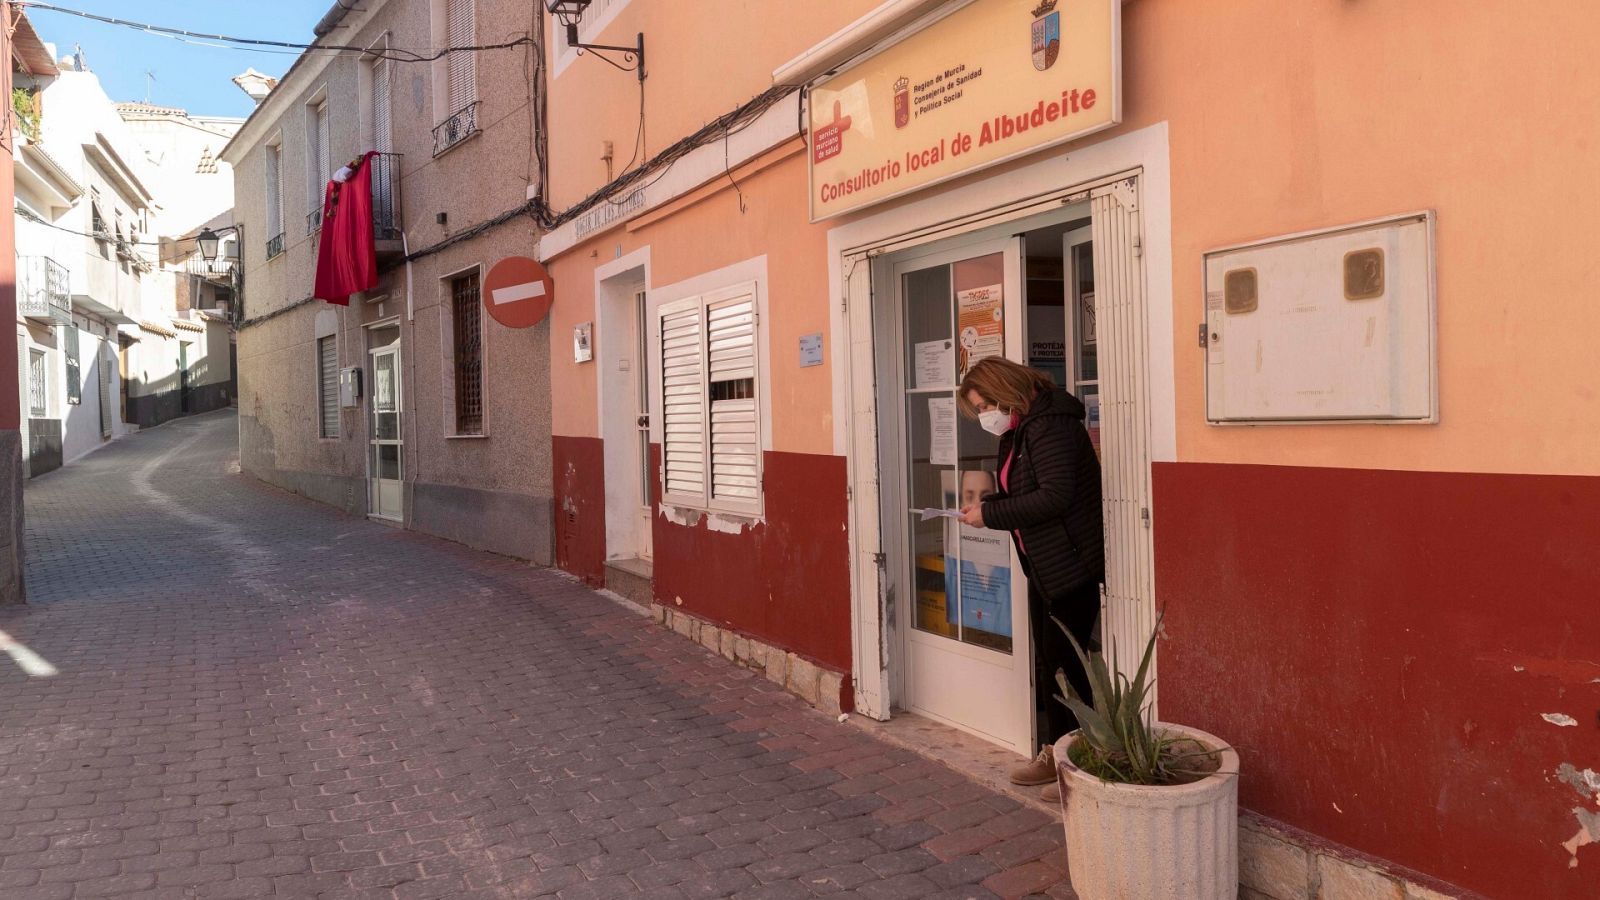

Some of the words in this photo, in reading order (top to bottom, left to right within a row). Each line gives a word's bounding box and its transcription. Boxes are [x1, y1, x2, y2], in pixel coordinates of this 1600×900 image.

[936, 75, 943, 84] de
[944, 64, 965, 79] Murcia
[947, 81, 954, 90] de
[956, 67, 982, 86] Sanidad
[914, 110, 918, 120] y
[943, 89, 963, 105] Social
[816, 136, 839, 151] murciano
[818, 127, 839, 141] servicio
[818, 150, 824, 159] de
[825, 143, 839, 156] salud
[820, 159, 900, 204] Consultorio
[906, 139, 945, 173] local
[951, 132, 972, 157] de
[978, 87, 1097, 148] Albudeite
